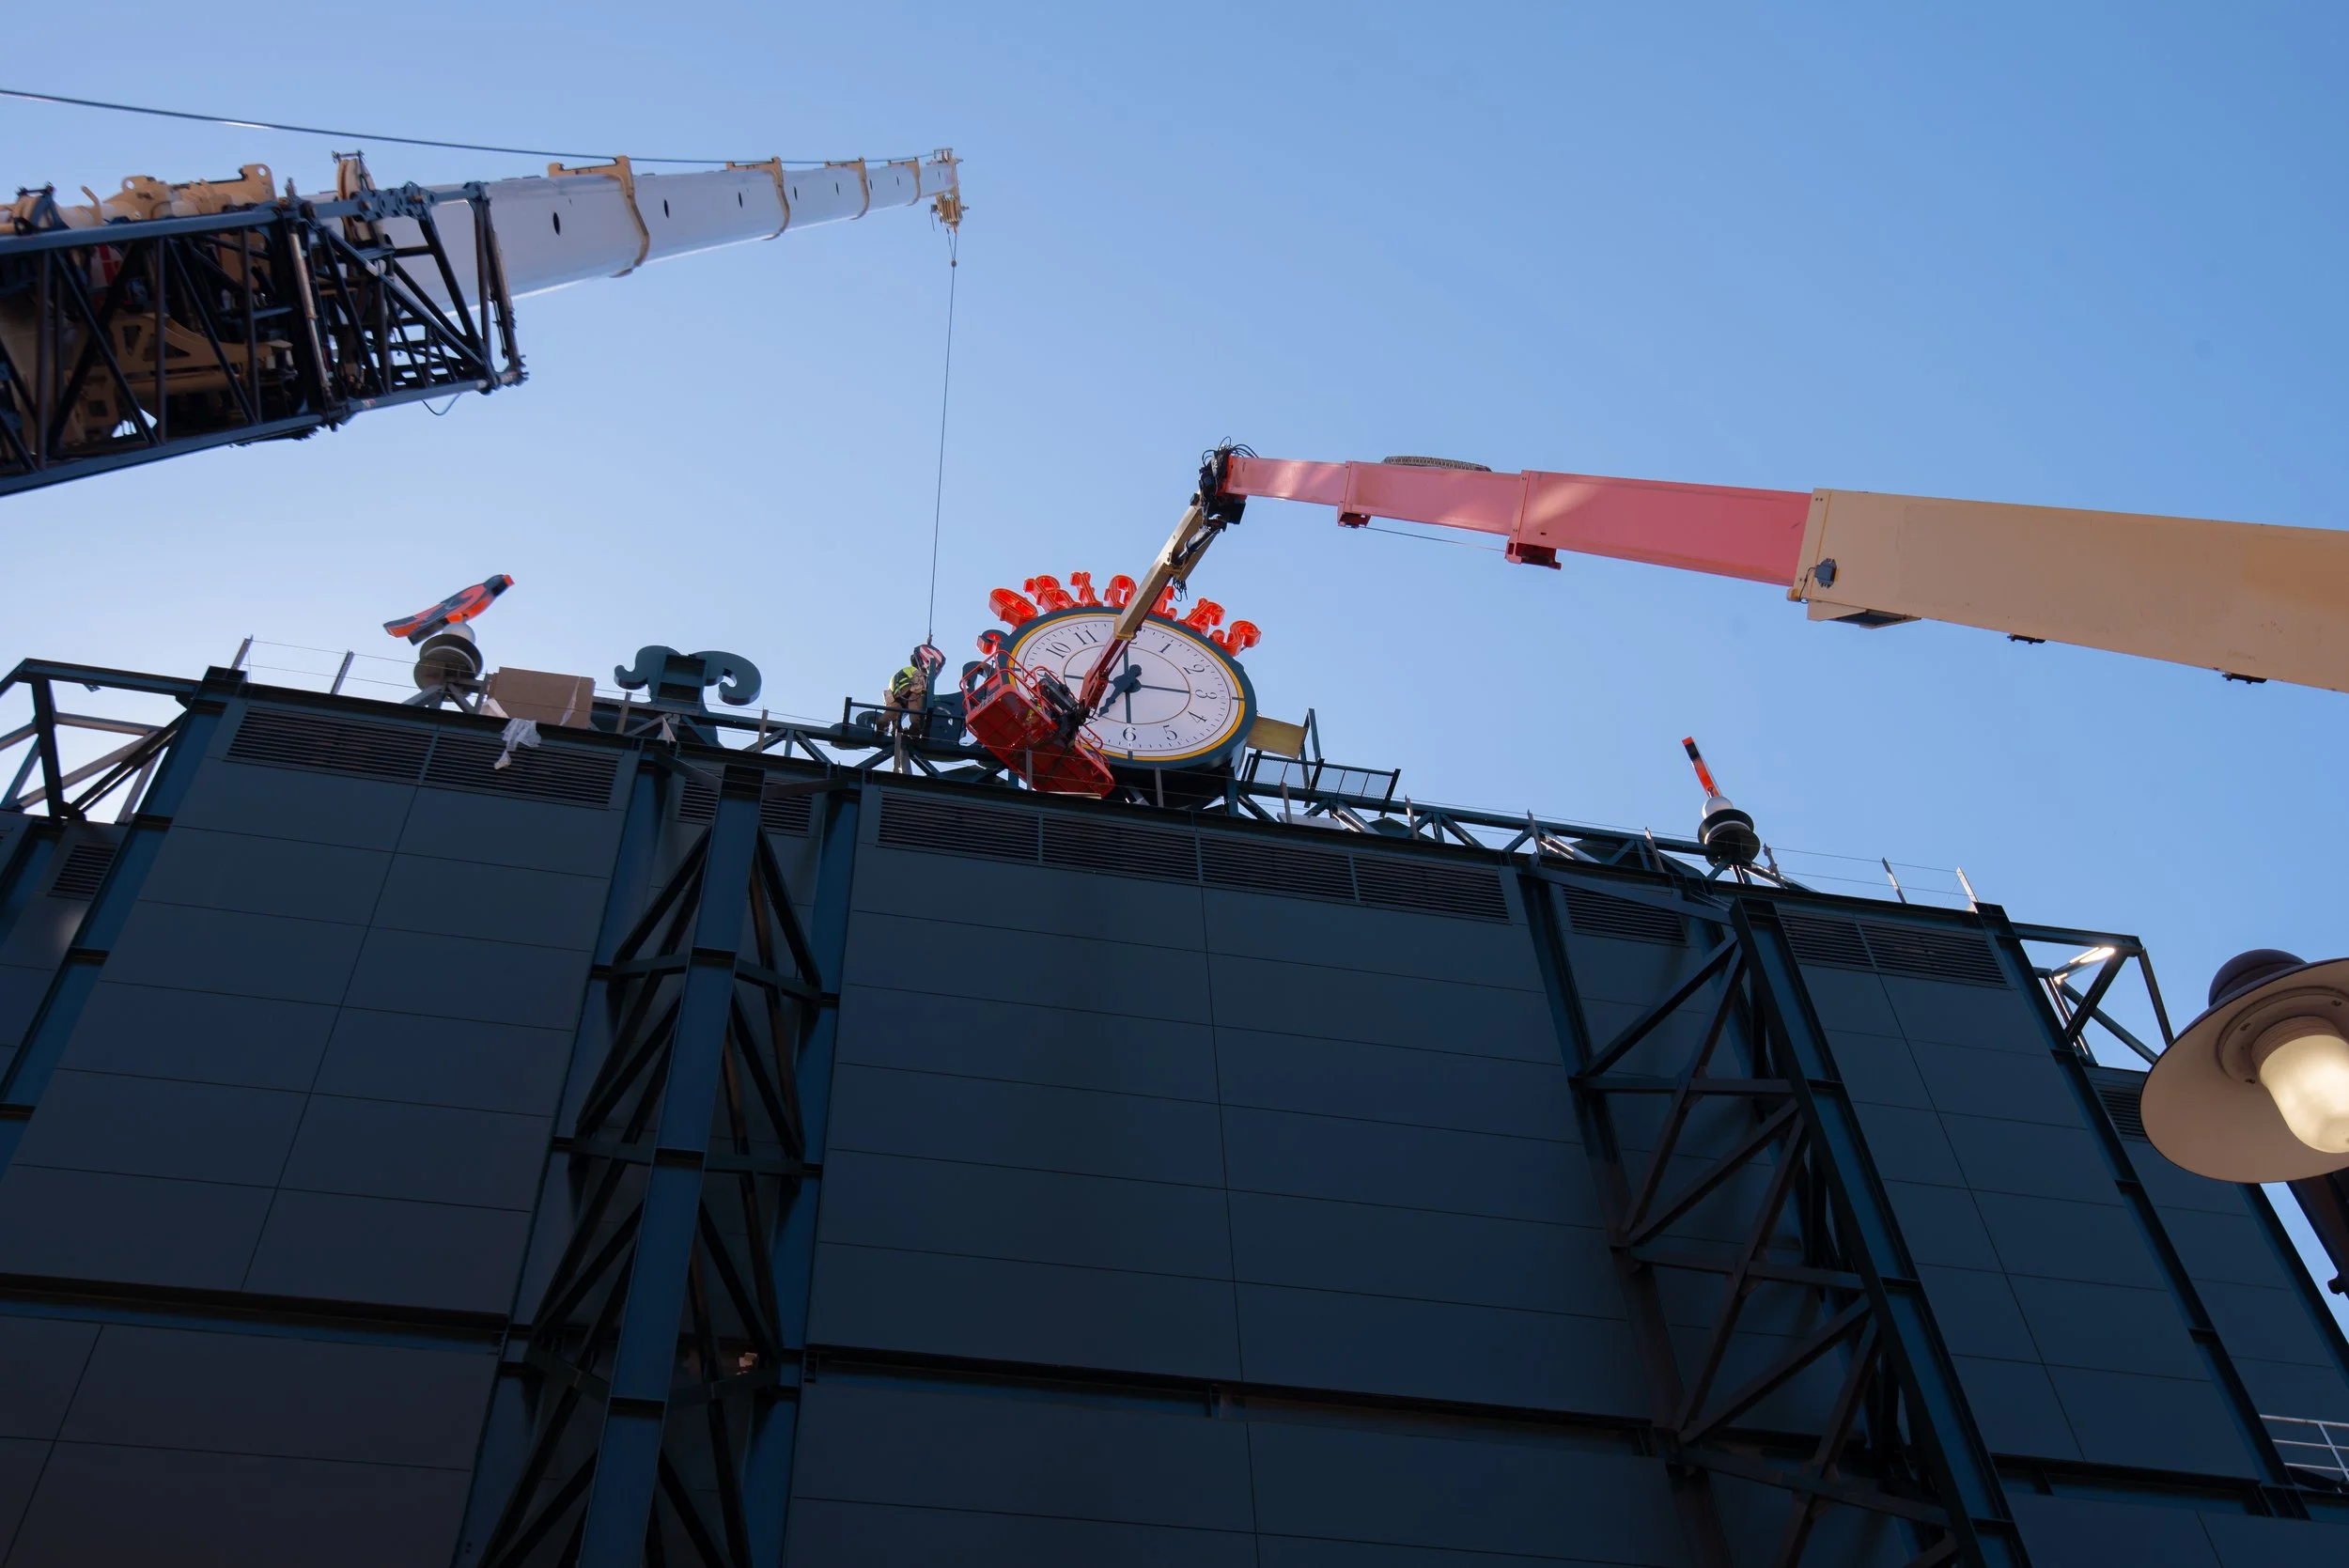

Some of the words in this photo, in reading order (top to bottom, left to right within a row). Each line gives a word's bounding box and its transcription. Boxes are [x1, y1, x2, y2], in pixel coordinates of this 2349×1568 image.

[1073, 629, 1098, 645] 11
[1045, 642, 1072, 659] 10
[1158, 643, 1172, 654] 1
[1182, 663, 1206, 675] 2
[1194, 689, 1218, 700] 3
[1187, 710, 1208, 723] 4
[1122, 726, 1137, 742] 6
[1162, 724, 1178, 741] 5
